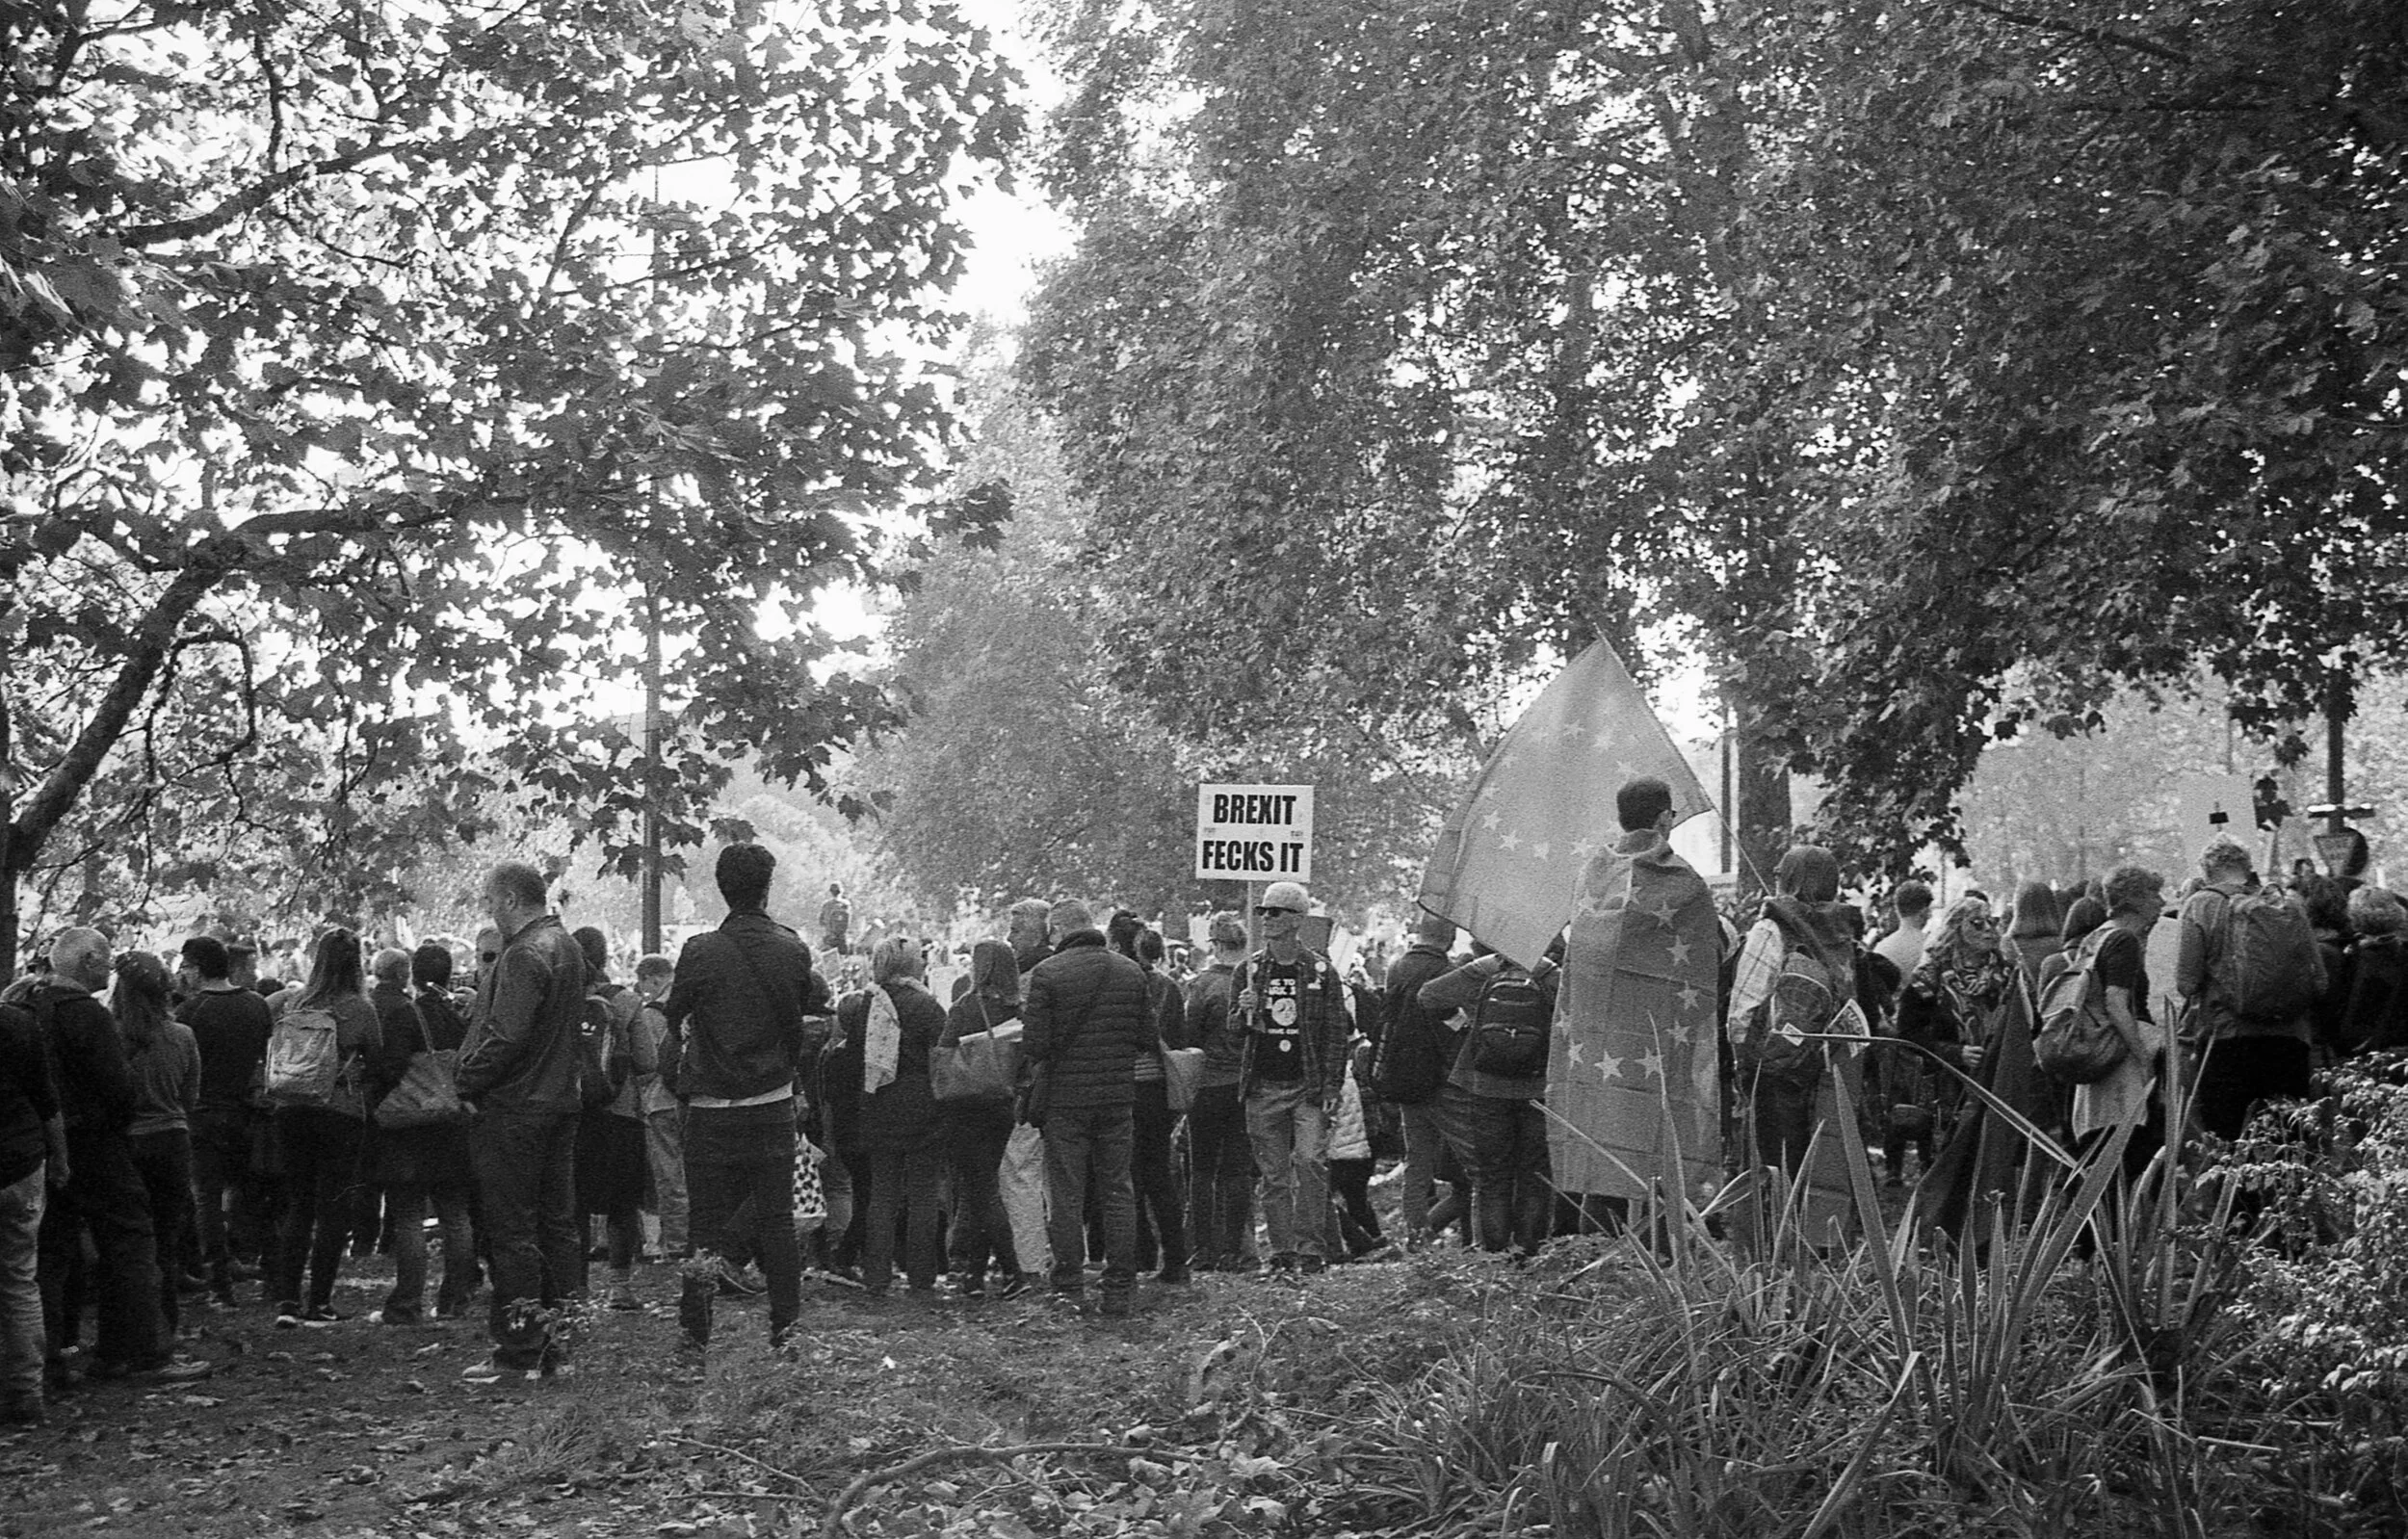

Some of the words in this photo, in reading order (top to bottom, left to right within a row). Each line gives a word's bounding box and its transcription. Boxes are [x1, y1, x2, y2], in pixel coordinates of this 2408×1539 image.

[1213, 794, 1297, 825] BREXIT
[1202, 840, 1274, 873] FECKS
[1279, 842, 1304, 873] IT
